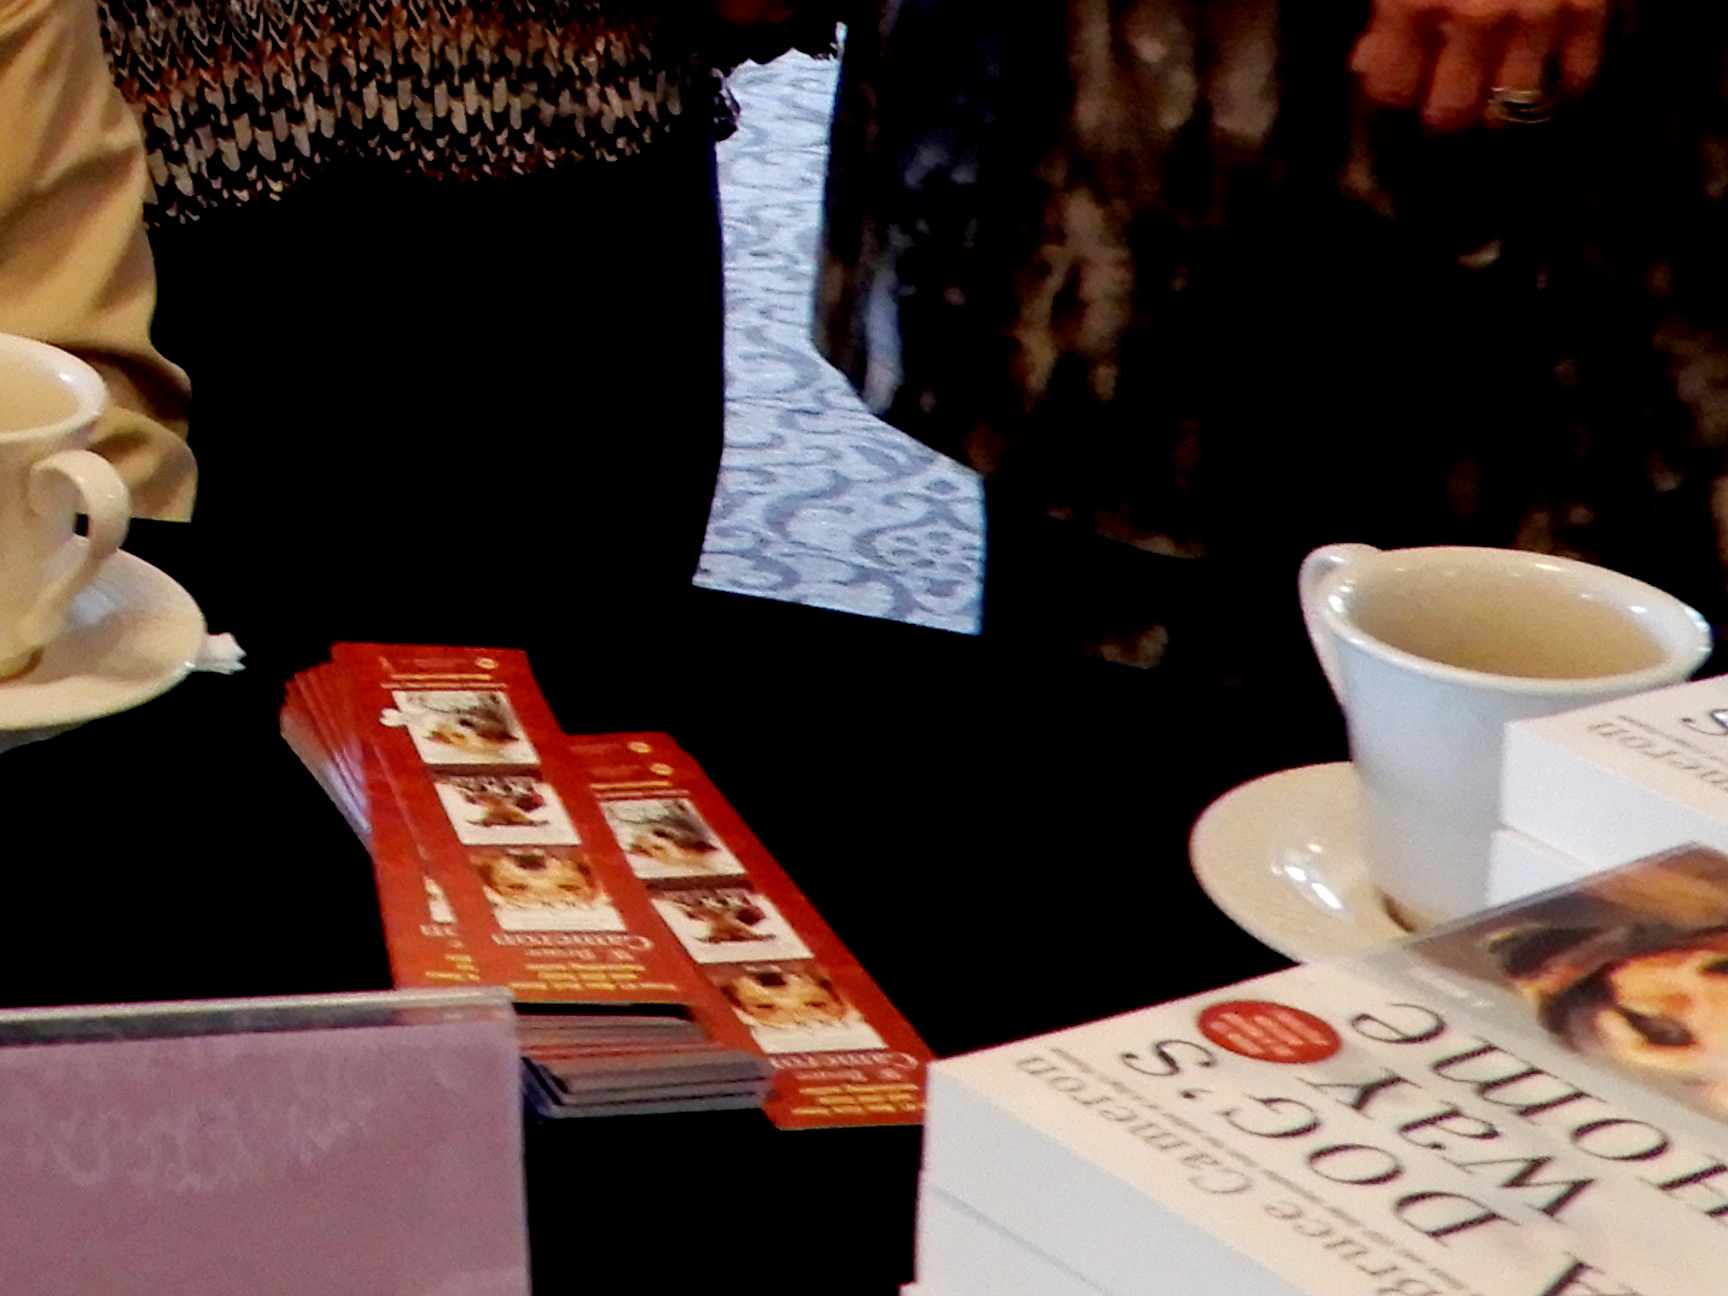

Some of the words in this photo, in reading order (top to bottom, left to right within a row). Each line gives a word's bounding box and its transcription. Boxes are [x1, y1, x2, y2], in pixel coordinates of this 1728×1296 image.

[1016, 1056, 1255, 1194] Cameron
[1121, 1038, 1523, 1248] DOG'S
[1263, 1200, 1448, 1296] Bruce
